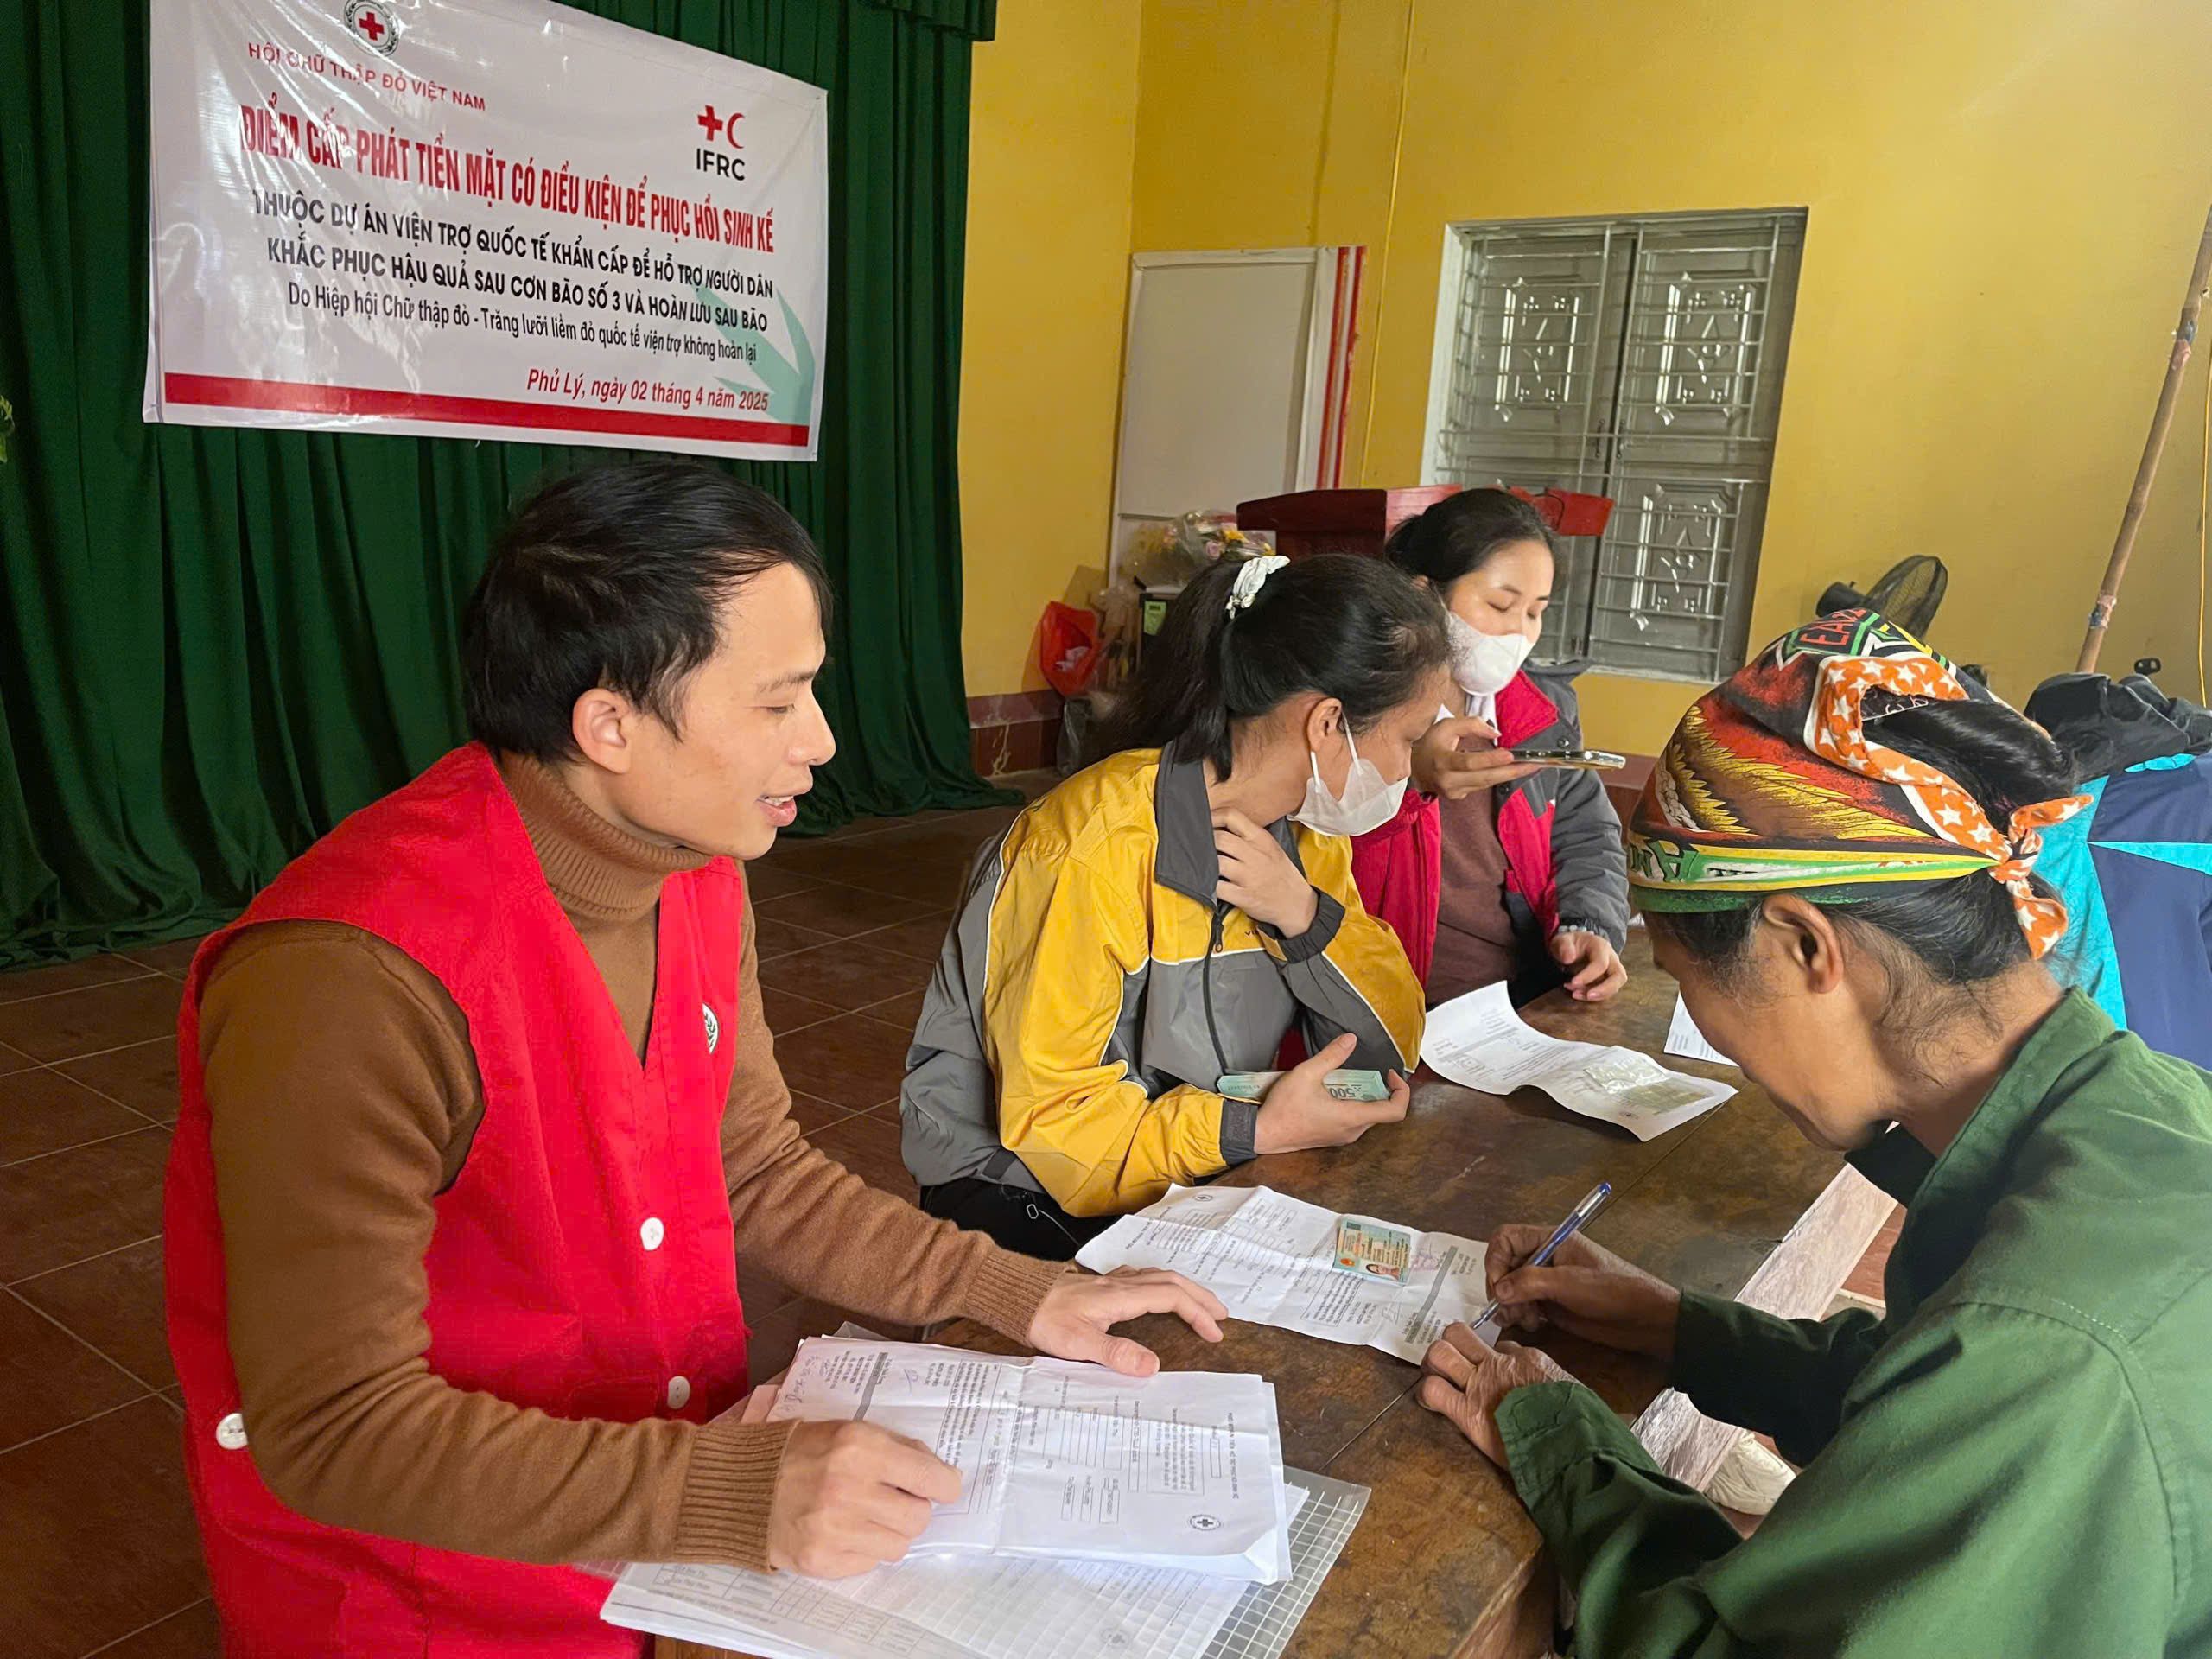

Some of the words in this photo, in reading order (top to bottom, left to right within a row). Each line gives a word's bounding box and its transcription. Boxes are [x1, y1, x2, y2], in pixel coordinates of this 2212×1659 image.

[248, 41, 280, 66] HỘI
[286, 51, 325, 73] CHỮ
[329, 61, 376, 85] THẬP
[383, 69, 406, 92] ĐỎ
[412, 80, 447, 102] VIỆT
[453, 90, 486, 111] NAM
[306, 107, 350, 170] CẤP
[356, 127, 410, 181] PHÁT
[466, 147, 506, 207] MẶT
[512, 156, 536, 207] CÓ
[584, 174, 621, 230] KIỆN
[626, 175, 647, 228] ĐỂ
[651, 193, 690, 243] PHỤC
[694, 193, 720, 242] HỒI
[723, 208, 753, 250] SINH
[757, 207, 774, 253] KẾ
[696, 148, 746, 181] IFRC
[252, 189, 325, 228] THUỘC
[331, 202, 357, 235] DỰ
[363, 203, 388, 234] ÁN
[393, 211, 432, 246] VIỆN
[438, 222, 472, 254] TRỢ
[476, 225, 526, 258] QUỐC
[531, 232, 550, 261] TẾ
[551, 235, 594, 270] KHẨN
[598, 245, 628, 274] CẤP
[632, 248, 650, 277] ĐỂ
[654, 253, 674, 281] HỖ
[678, 264, 702, 292] TRỢ
[705, 269, 743, 294] NGƯỜI
[747, 273, 772, 298] DÂN
[267, 231, 326, 269] KHẮC
[332, 247, 385, 282] PHỤC
[391, 252, 427, 288] HẬU
[432, 260, 469, 289] QUẢ
[475, 270, 505, 295] SAU
[511, 274, 546, 301] CƠN
[552, 278, 583, 306] BÃO
[588, 281, 608, 309] SỐ
[612, 290, 620, 310] 3
[625, 289, 645, 315] VÀ
[649, 295, 688, 321] HOÀN
[690, 301, 711, 324] LƯU
[715, 307, 738, 327] SAU
[741, 307, 767, 332] BÃO
[289, 281, 310, 307] Do
[316, 285, 349, 317] Hiệp
[354, 290, 378, 320] hội
[383, 294, 414, 319] Chữ
[419, 300, 448, 328] thập
[454, 303, 470, 327] đỏ
[480, 308, 518, 338] Trăng
[522, 313, 548, 336] lưỡi
[551, 313, 576, 340] liềm
[581, 321, 595, 342] đỏ
[599, 321, 626, 348] quốc
[630, 321, 640, 347] tế
[644, 329, 664, 354] viện
[666, 334, 681, 357] trợ
[684, 334, 715, 361] không
[718, 339, 743, 359] hoàn
[746, 342, 756, 365] lại
[527, 367, 559, 392] Phủ
[563, 373, 585, 400] Lý,
[590, 376, 628, 404] ngày
[630, 380, 648, 401] 02
[652, 382, 691, 410] tháng
[695, 386, 704, 407] 4
[708, 387, 734, 408] năm
[739, 390, 768, 411] 2025
